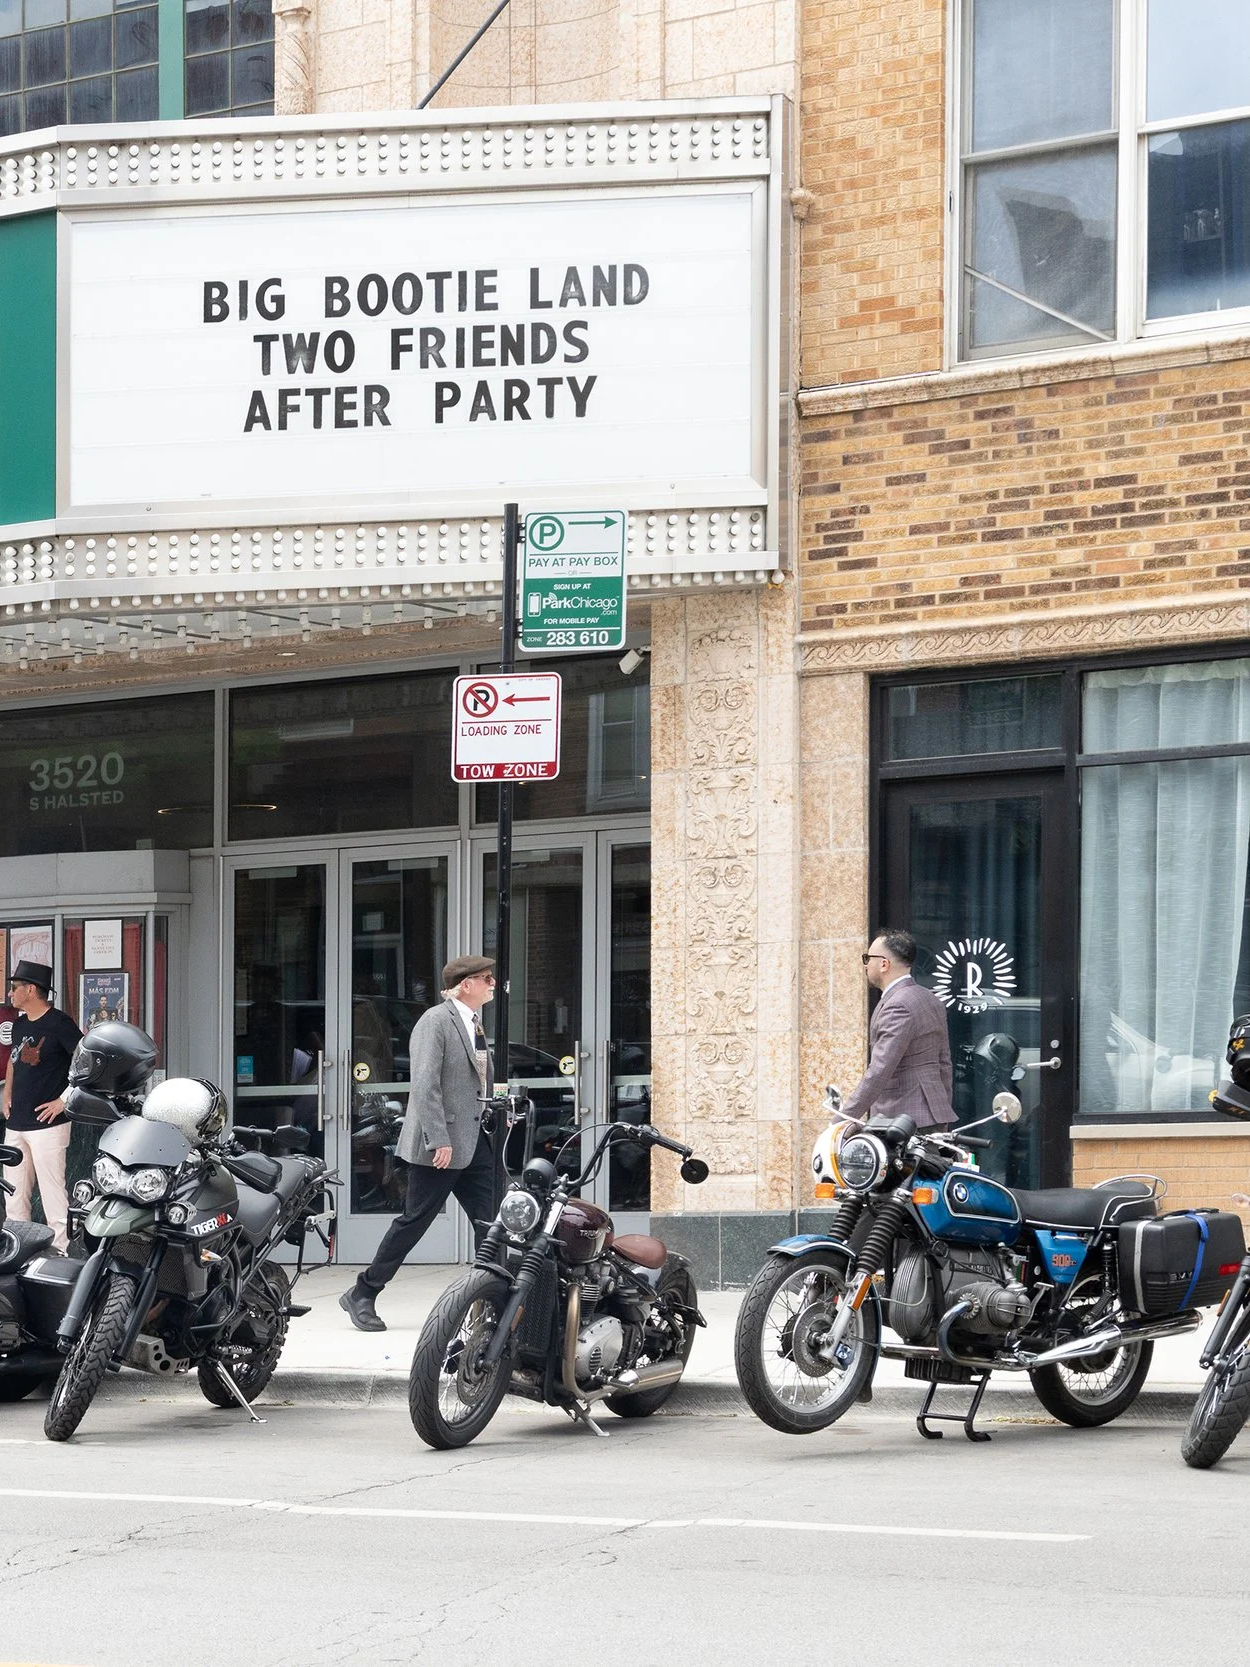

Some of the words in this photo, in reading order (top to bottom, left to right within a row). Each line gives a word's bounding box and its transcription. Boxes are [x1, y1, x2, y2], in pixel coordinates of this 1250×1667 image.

[203, 278, 286, 324] BIG
[324, 269, 500, 319] BOOTIE
[529, 263, 650, 310] LAND
[253, 329, 356, 376] TWO
[391, 320, 590, 371] FRIENDS
[243, 384, 392, 433] AFTER
[434, 375, 598, 424] PARTY
[528, 557, 550, 568] PAY
[551, 557, 566, 568] AT
[568, 556, 592, 567] PAY
[593, 556, 619, 567] BOX
[567, 569, 578, 577] OR
[553, 583, 570, 591] SIGN
[542, 596, 618, 610] ParkChicago
[559, 617, 585, 625] MOBILE
[586, 616, 599, 624] PAY
[546, 631, 576, 646] 283
[579, 630, 609, 645] 610
[461, 725, 508, 737] LOADING
[513, 724, 542, 735] ZONE
[29, 751, 125, 792] 3520
[460, 765, 495, 779] TOW
[503, 763, 549, 778] ZONE
[29, 797, 40, 811] S
[44, 790, 125, 810] HALSTED
[967, 962, 984, 999] R
[958, 1002, 988, 1014] 1929
